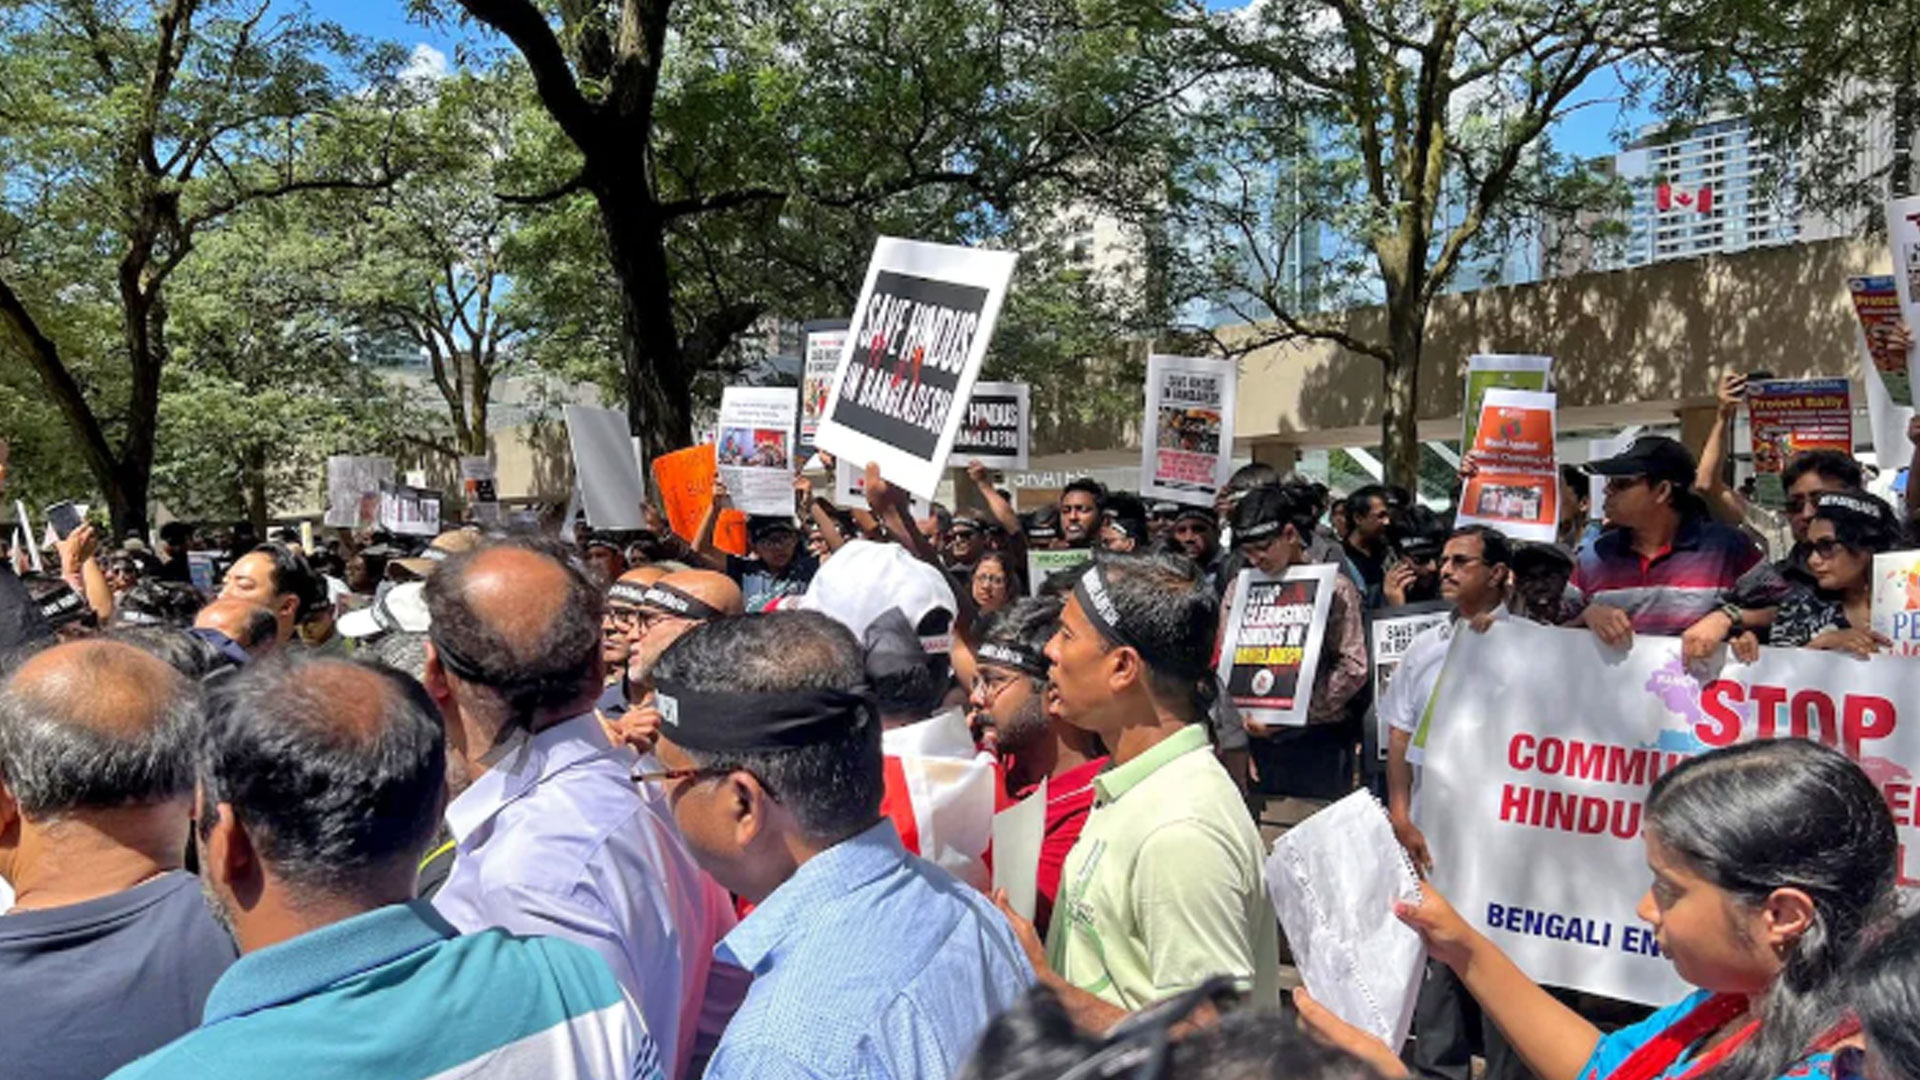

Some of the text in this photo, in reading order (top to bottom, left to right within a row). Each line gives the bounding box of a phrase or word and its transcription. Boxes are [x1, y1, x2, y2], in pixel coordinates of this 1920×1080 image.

[859, 293, 977, 374] SAVE HINDUS
[840, 361, 953, 435] IN BANGLADESH
[969, 402, 1018, 427] HINDUS
[1750, 397, 1802, 410] Protest
[1696, 678, 1897, 758] STOP
[1508, 733, 1690, 786] COMMU
[1500, 783, 1645, 840] HINDU
[1487, 902, 1612, 948] BENGALI
